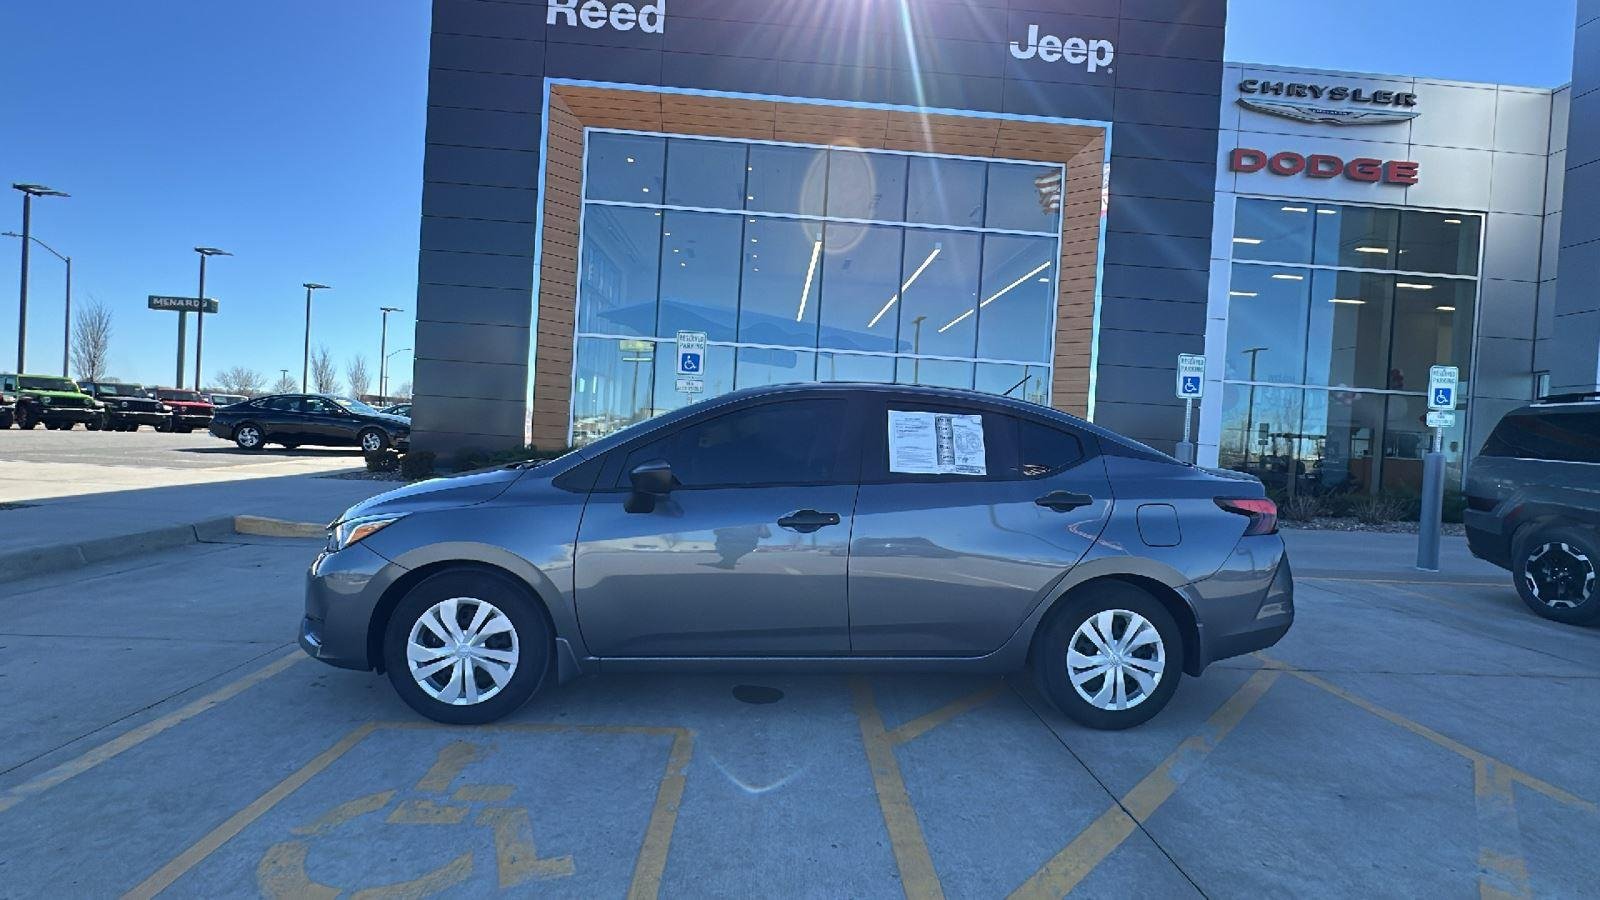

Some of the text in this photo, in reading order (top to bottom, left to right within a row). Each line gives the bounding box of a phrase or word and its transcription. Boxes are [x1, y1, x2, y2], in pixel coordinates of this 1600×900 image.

[546, 0, 666, 34] Reed
[1009, 24, 1114, 73] Jeep
[1239, 79, 1418, 106] CHRYSLER
[1230, 148, 1419, 185] DODGE
[679, 334, 704, 342] RESERVED
[679, 342, 704, 350] PARKING
